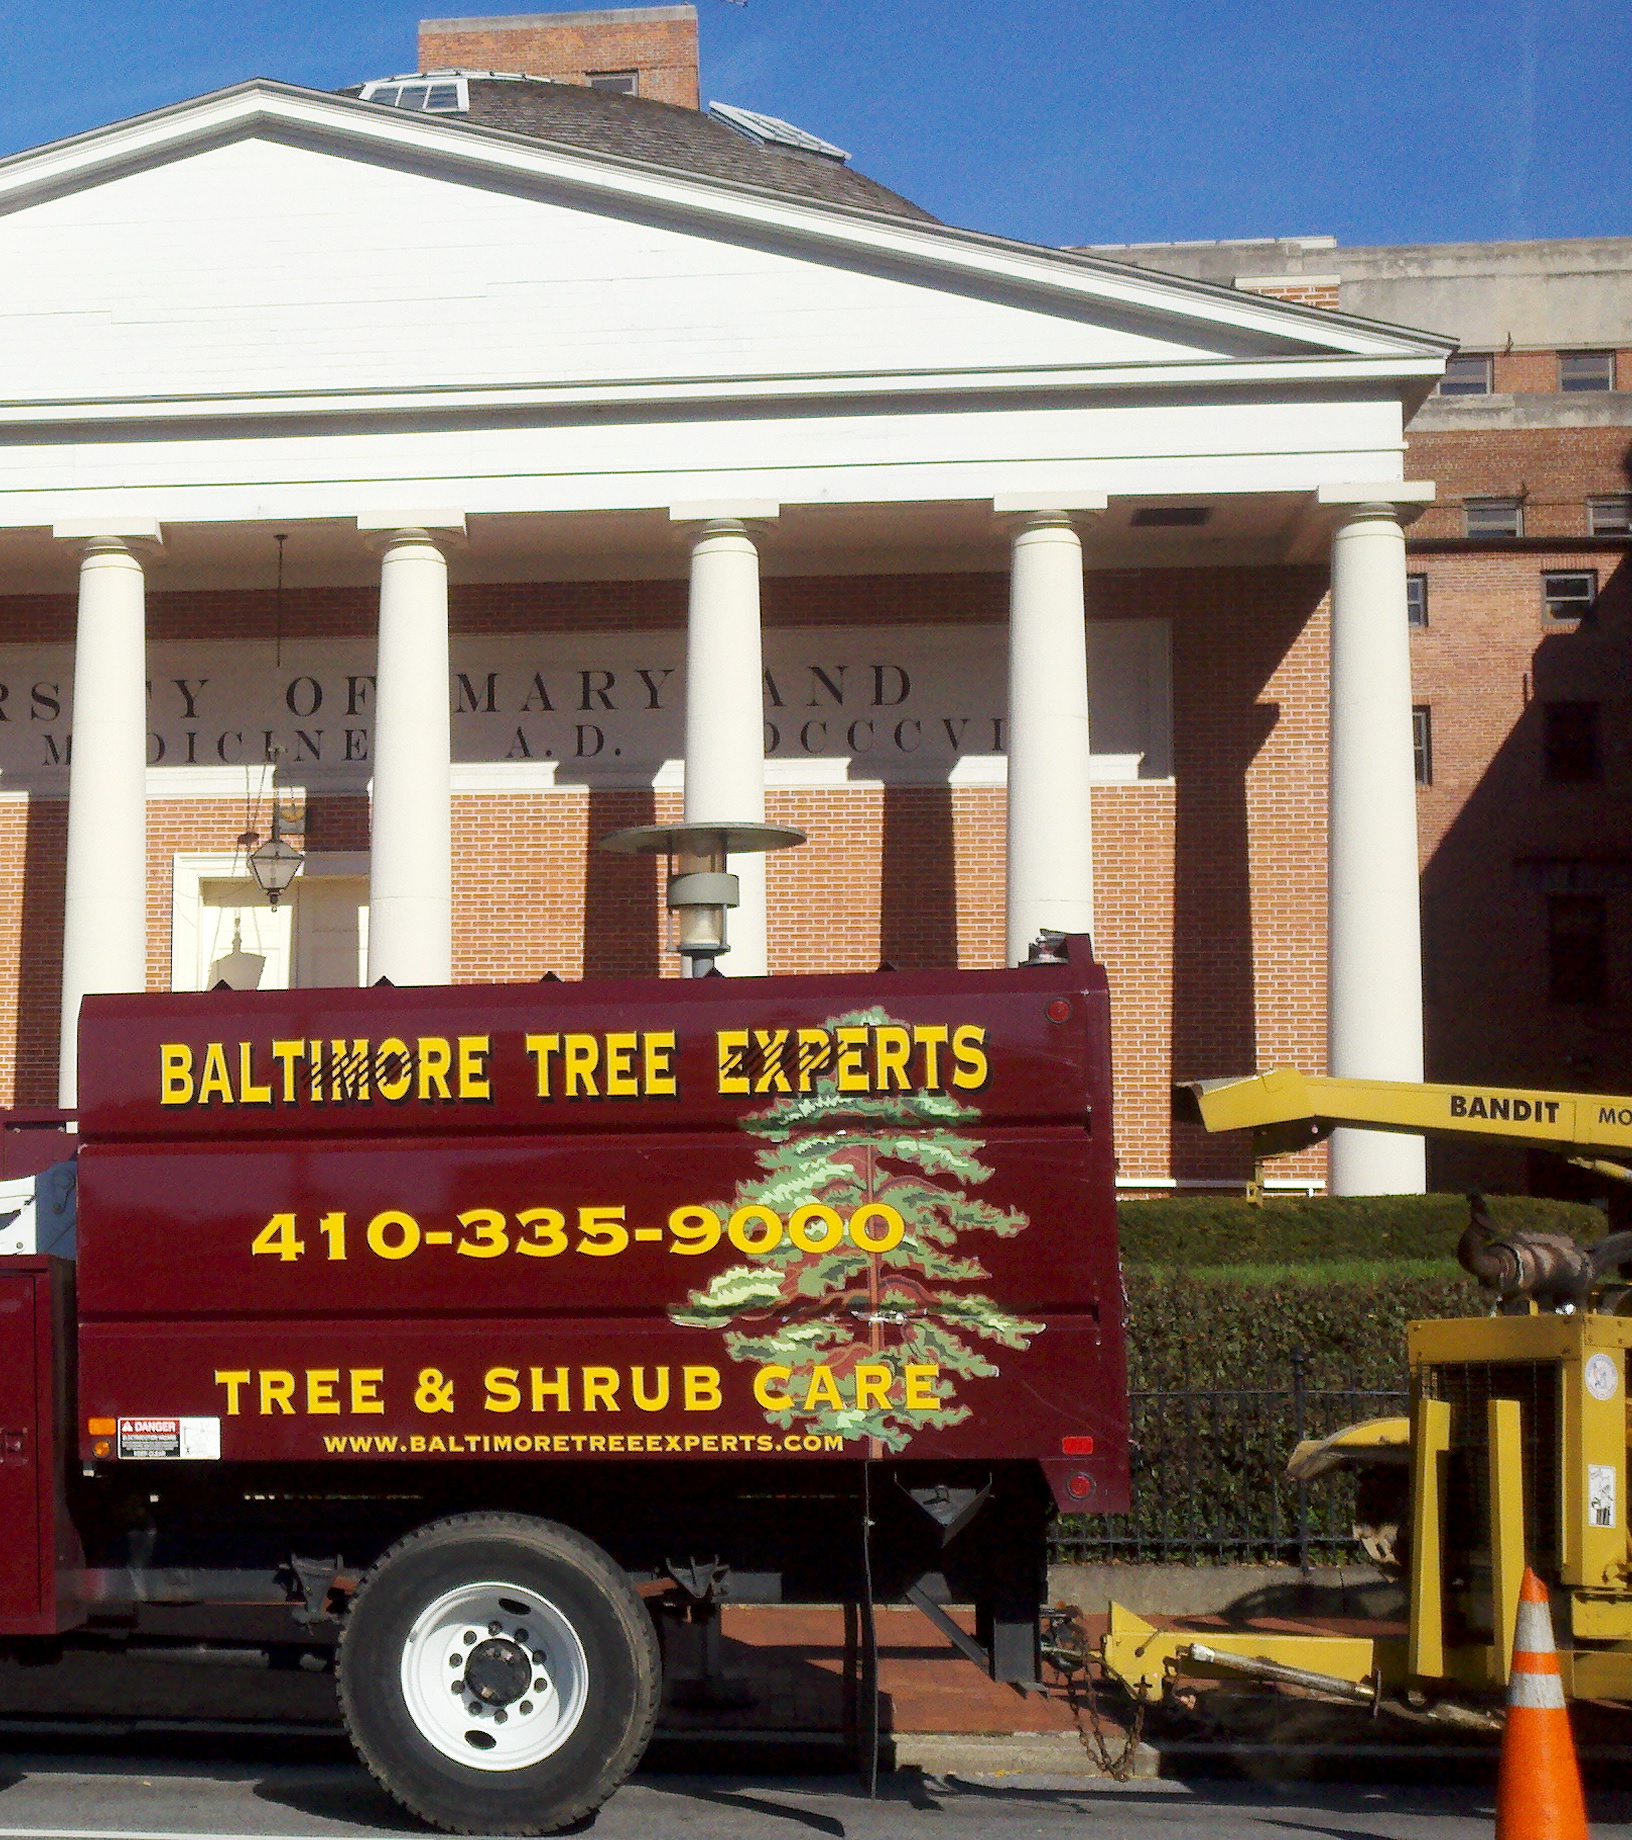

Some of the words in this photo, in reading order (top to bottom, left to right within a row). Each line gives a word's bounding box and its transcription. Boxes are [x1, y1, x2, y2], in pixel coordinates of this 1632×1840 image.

[286, 675, 377, 717] OF
[455, 665, 911, 712] MARYAND
[41, 729, 368, 766] MDICINE
[160, 1035, 491, 1104] BALTIMORE
[526, 1030, 676, 1097] TREE
[716, 1024, 988, 1094] EXPERTS
[1451, 1095, 1560, 1123] BANDIT
[251, 1203, 905, 1262] 410-335-9000
[214, 1369, 385, 1415] TREE
[414, 1368, 454, 1413] &
[484, 1366, 723, 1412] SHRUB
[753, 1363, 941, 1411] CARE
[134, 1421, 176, 1432] DANGER
[322, 1434, 844, 1453] WWW.BALTIMORETREEEXPERTS.COM
